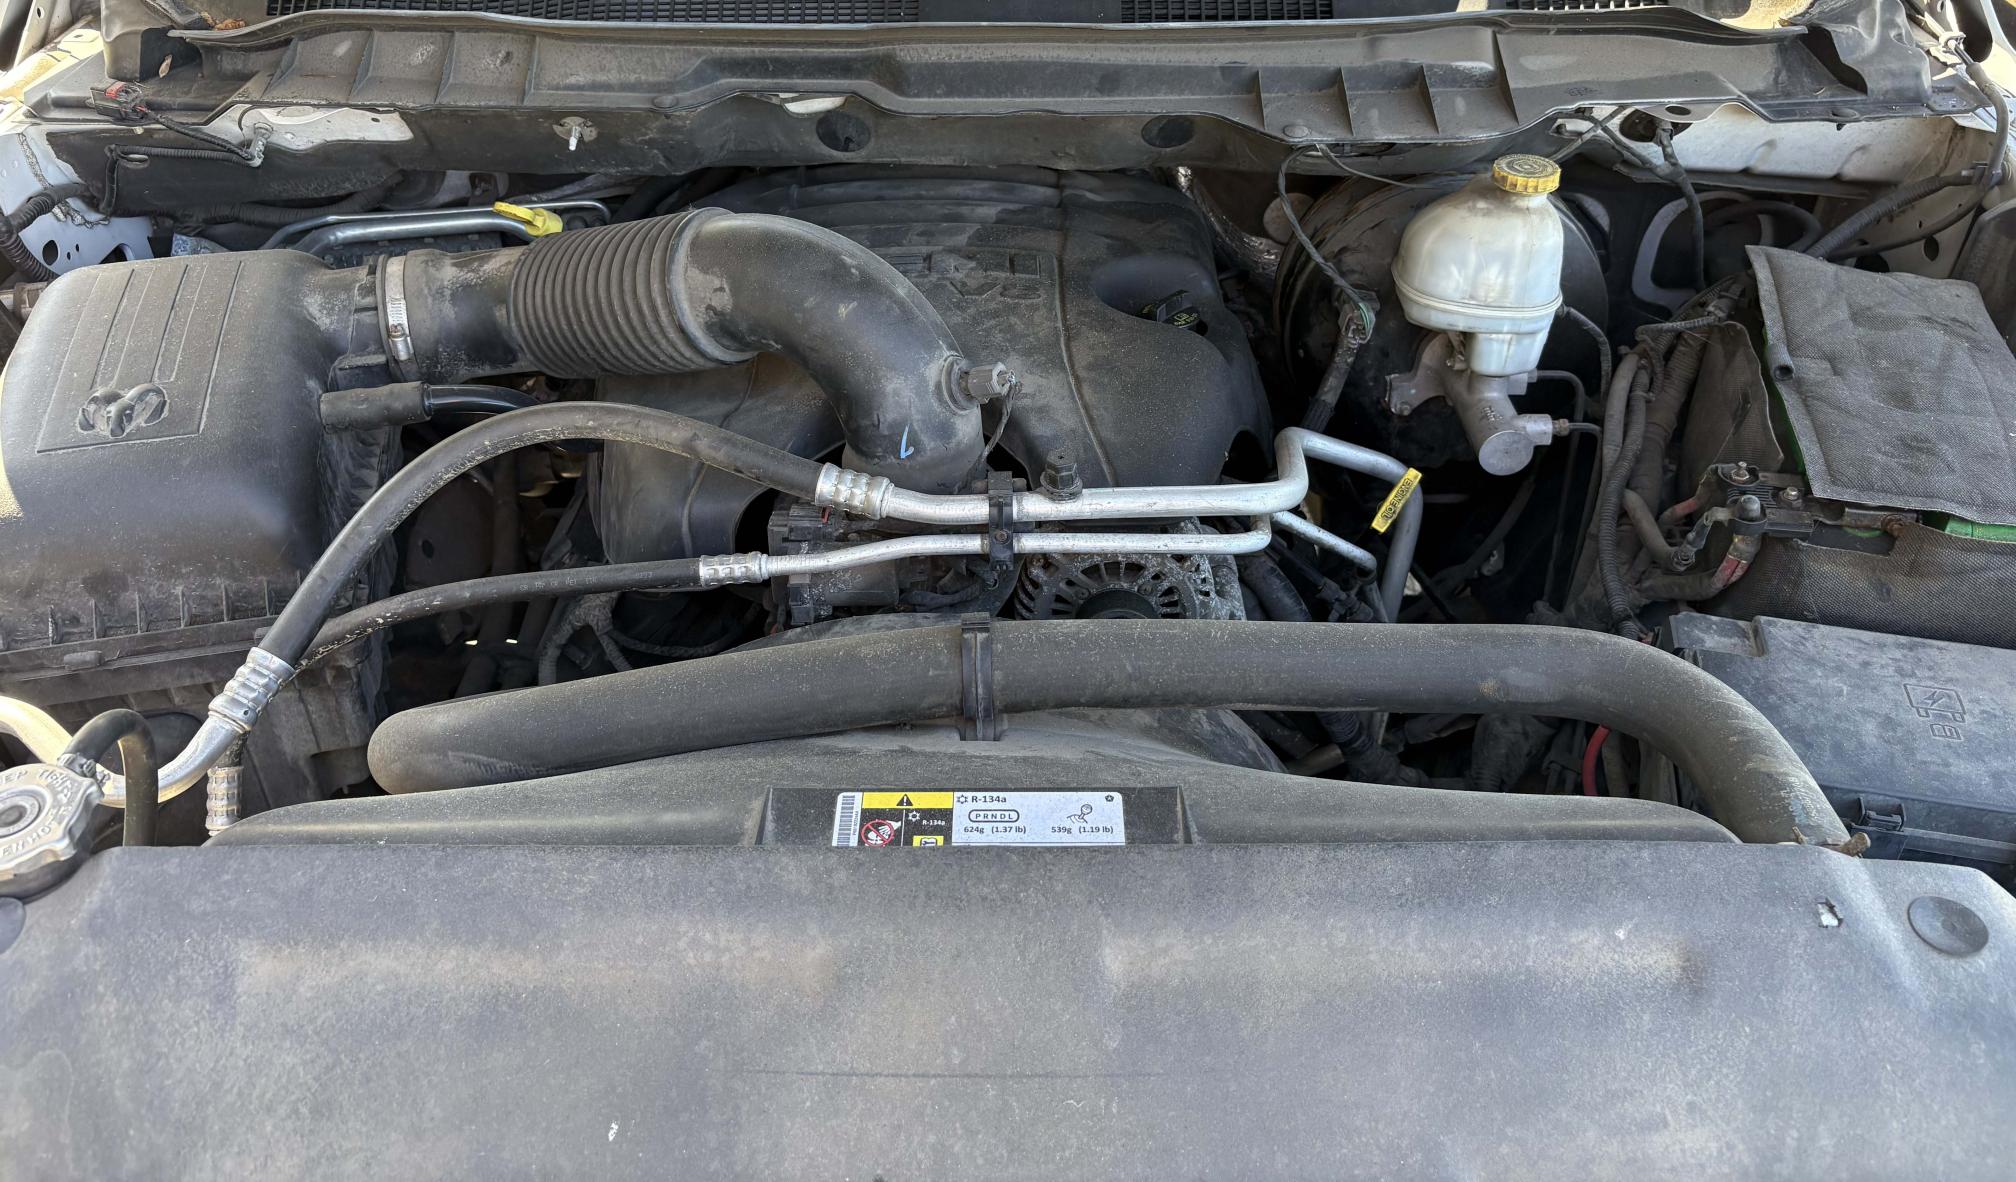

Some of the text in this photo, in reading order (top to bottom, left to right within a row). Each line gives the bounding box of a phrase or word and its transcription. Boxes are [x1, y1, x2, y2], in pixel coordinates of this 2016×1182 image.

[1391, 478, 1413, 506] ENGINE
[971, 795, 1007, 803] R-134a
[963, 825, 1027, 834] 624g (1.37 lb)
[1051, 825, 1114, 834] 539g (1.19 lb)
